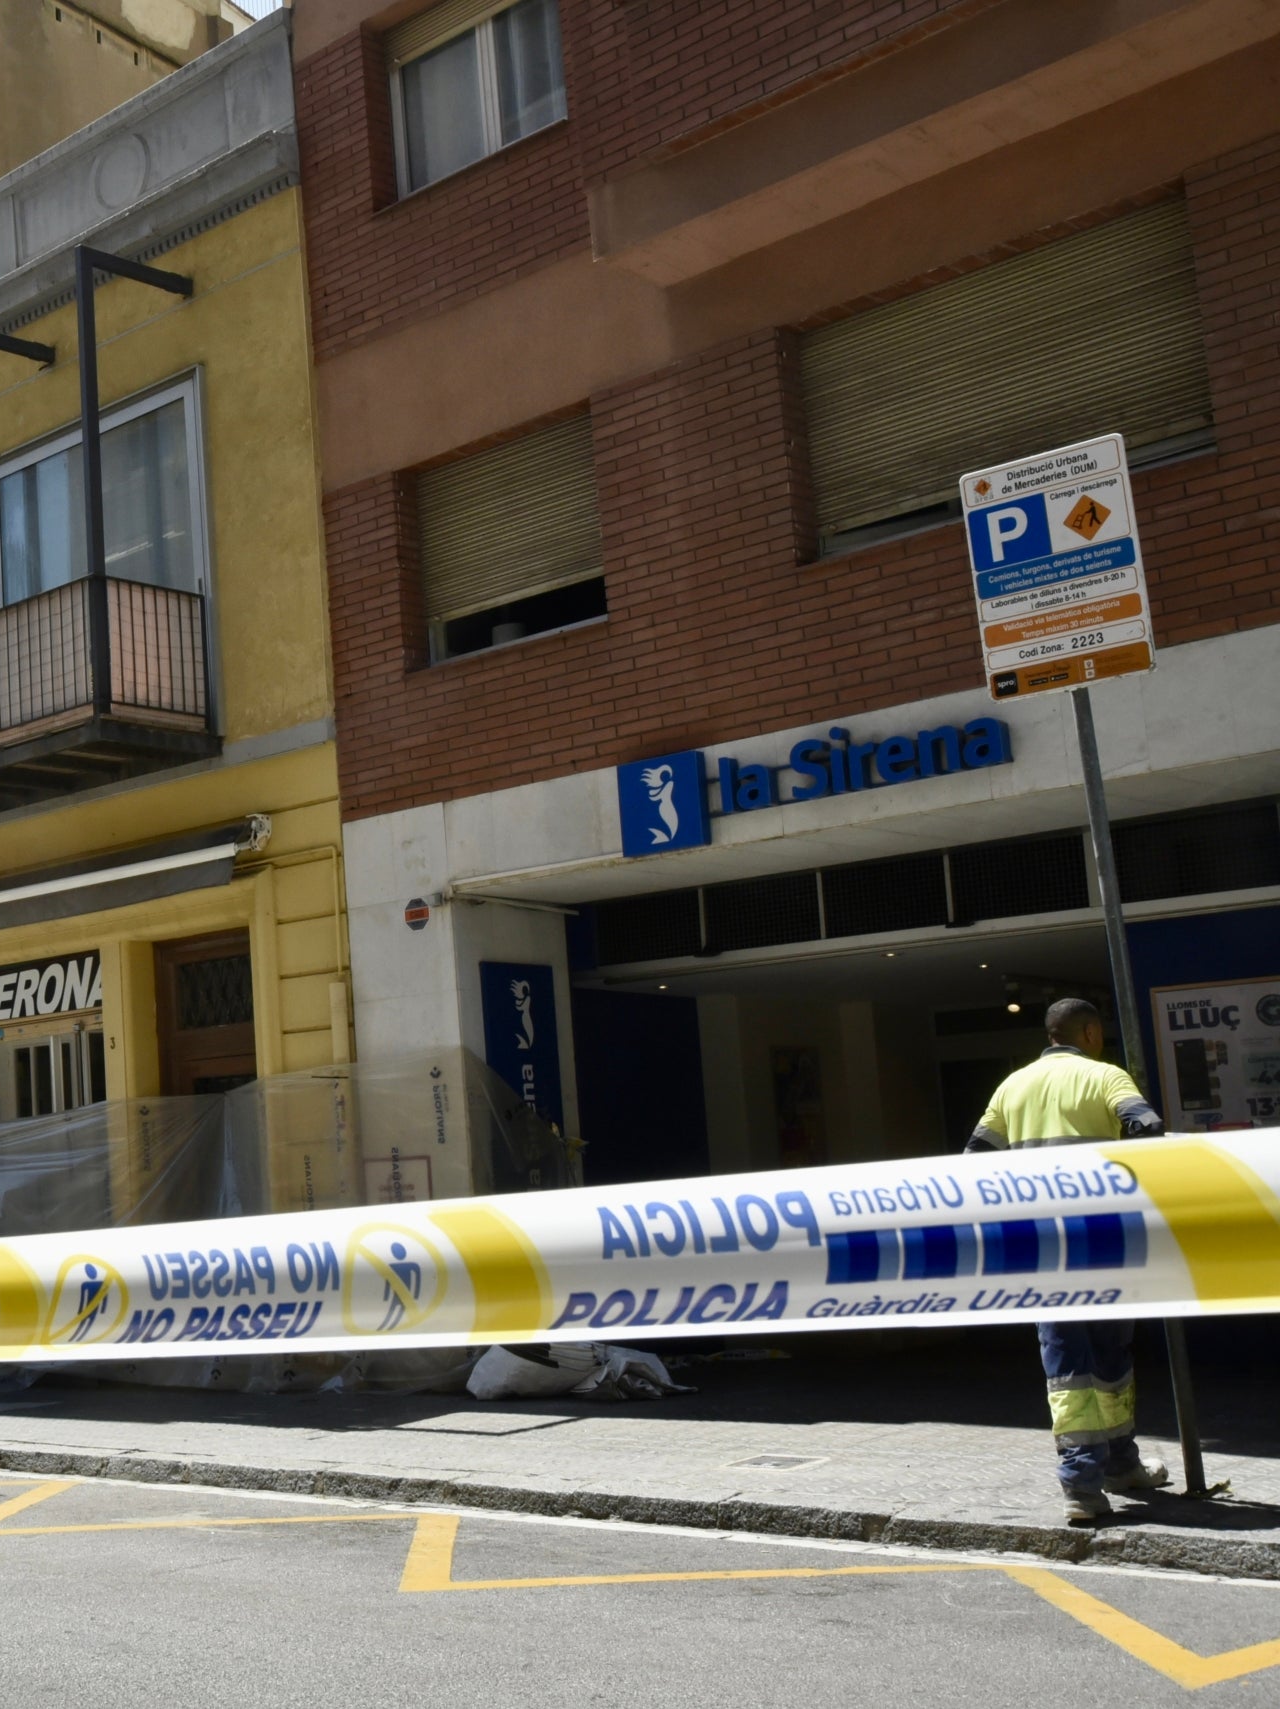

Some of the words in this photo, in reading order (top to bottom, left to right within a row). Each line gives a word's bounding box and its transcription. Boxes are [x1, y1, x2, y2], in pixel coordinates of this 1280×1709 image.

[1001, 485, 1012, 494] de
[1014, 471, 1067, 491] Mercaderies
[1070, 460, 1097, 476] (DUM)
[1007, 461, 1054, 481] Distribució
[1055, 453, 1088, 468] Urbana
[1049, 488, 1076, 501] Càrrega
[1080, 478, 1118, 493] descàrrega
[987, 507, 1028, 563] P
[1083, 552, 1093, 560] de
[1059, 569, 1069, 577] de
[991, 594, 1028, 609] Laborables
[1029, 591, 1039, 599] de
[1069, 577, 1103, 591] divendres
[1019, 648, 1039, 659] Codi
[1040, 643, 1065, 655] Zona:
[1071, 632, 1104, 649] 2223
[718, 757, 776, 814] la
[789, 717, 1013, 799] Sirena
[1166, 1000, 1198, 1010] LLOMS
[1199, 999, 1212, 1007] DE
[1168, 1005, 1240, 1031] LLUÇ
[110, 1036, 116, 1050] 3
[548, 1280, 790, 1332] POLICIA
[806, 1288, 959, 1320] Guàrdia
[967, 1286, 1123, 1313] Urbana
[115, 1308, 176, 1345] NO
[173, 1301, 324, 1343] PASSEU
